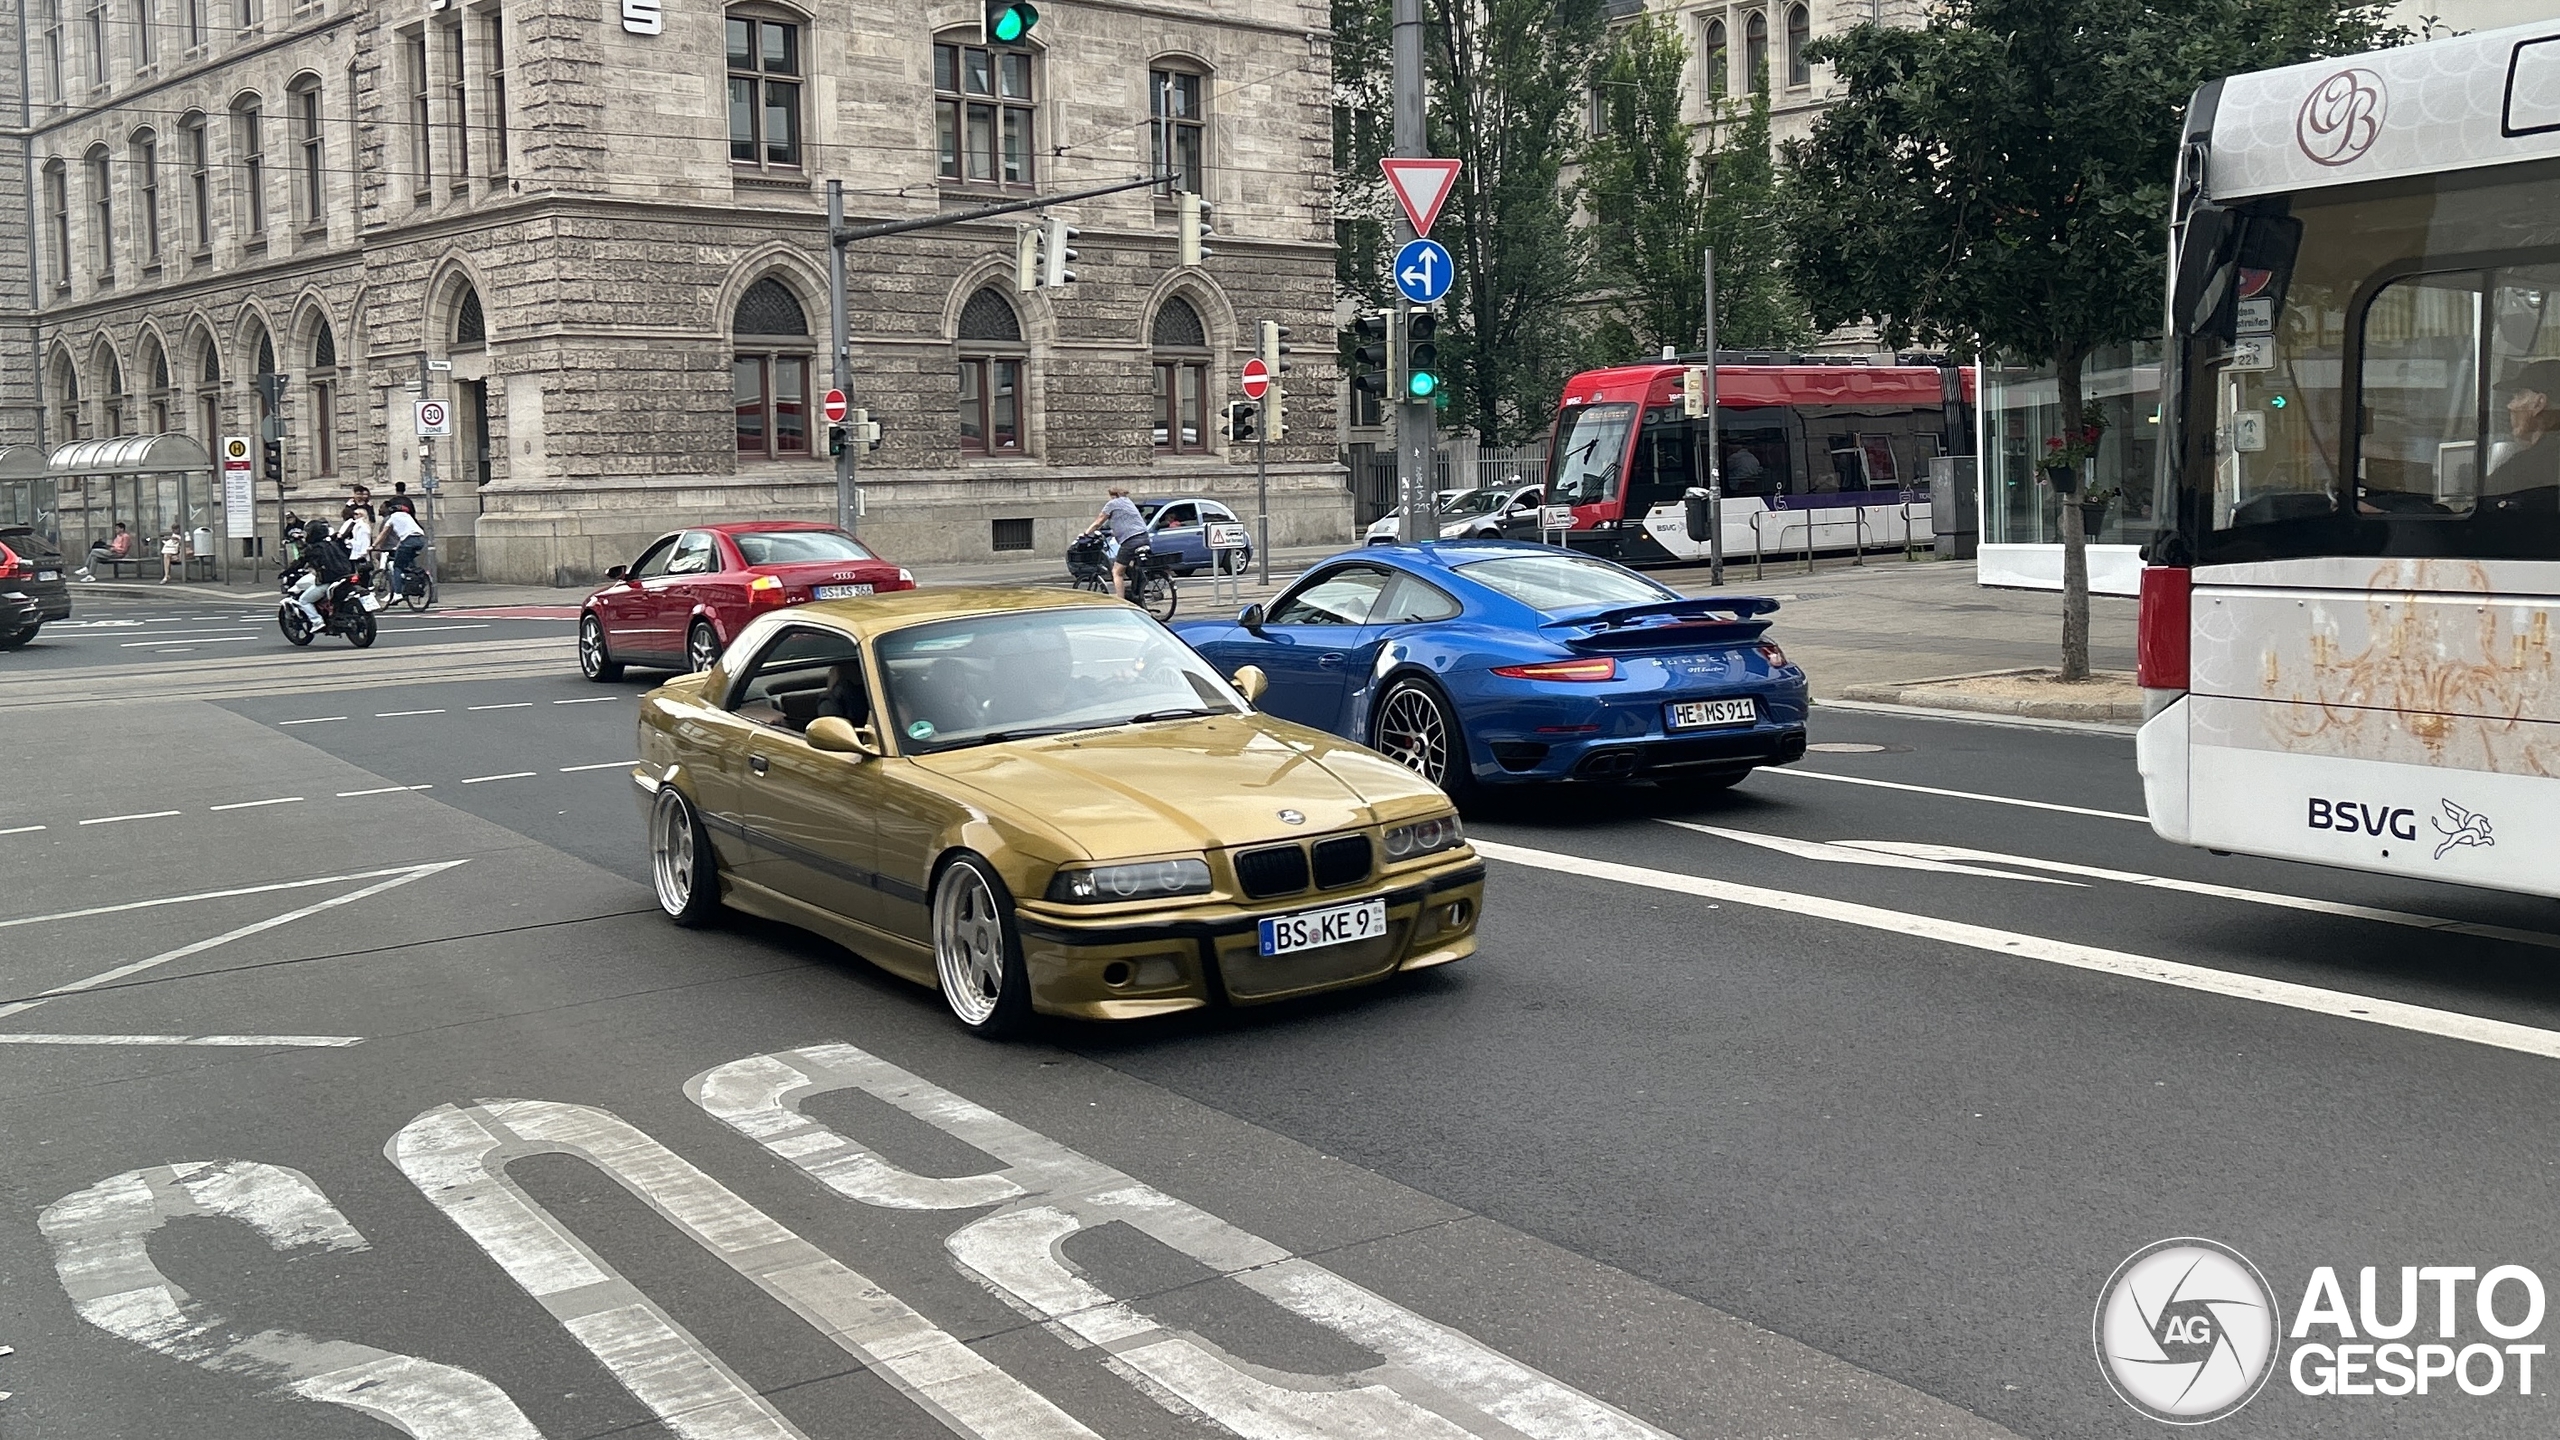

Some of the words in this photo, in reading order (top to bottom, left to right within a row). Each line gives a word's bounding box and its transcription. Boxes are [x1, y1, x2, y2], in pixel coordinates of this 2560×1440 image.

[426, 409, 440, 420] 30
[1657, 524, 1677, 532] BSVG
[821, 587, 834, 597] BS
[840, 586, 853, 597] AS
[1675, 705, 1697, 724] HE
[1704, 703, 1725, 722] MS
[1727, 701, 1754, 720] 911
[2308, 797, 2416, 841] BSVG
[1276, 920, 1307, 950] BS
[1322, 912, 1352, 942] KE
[1356, 909, 1369, 935] 9
